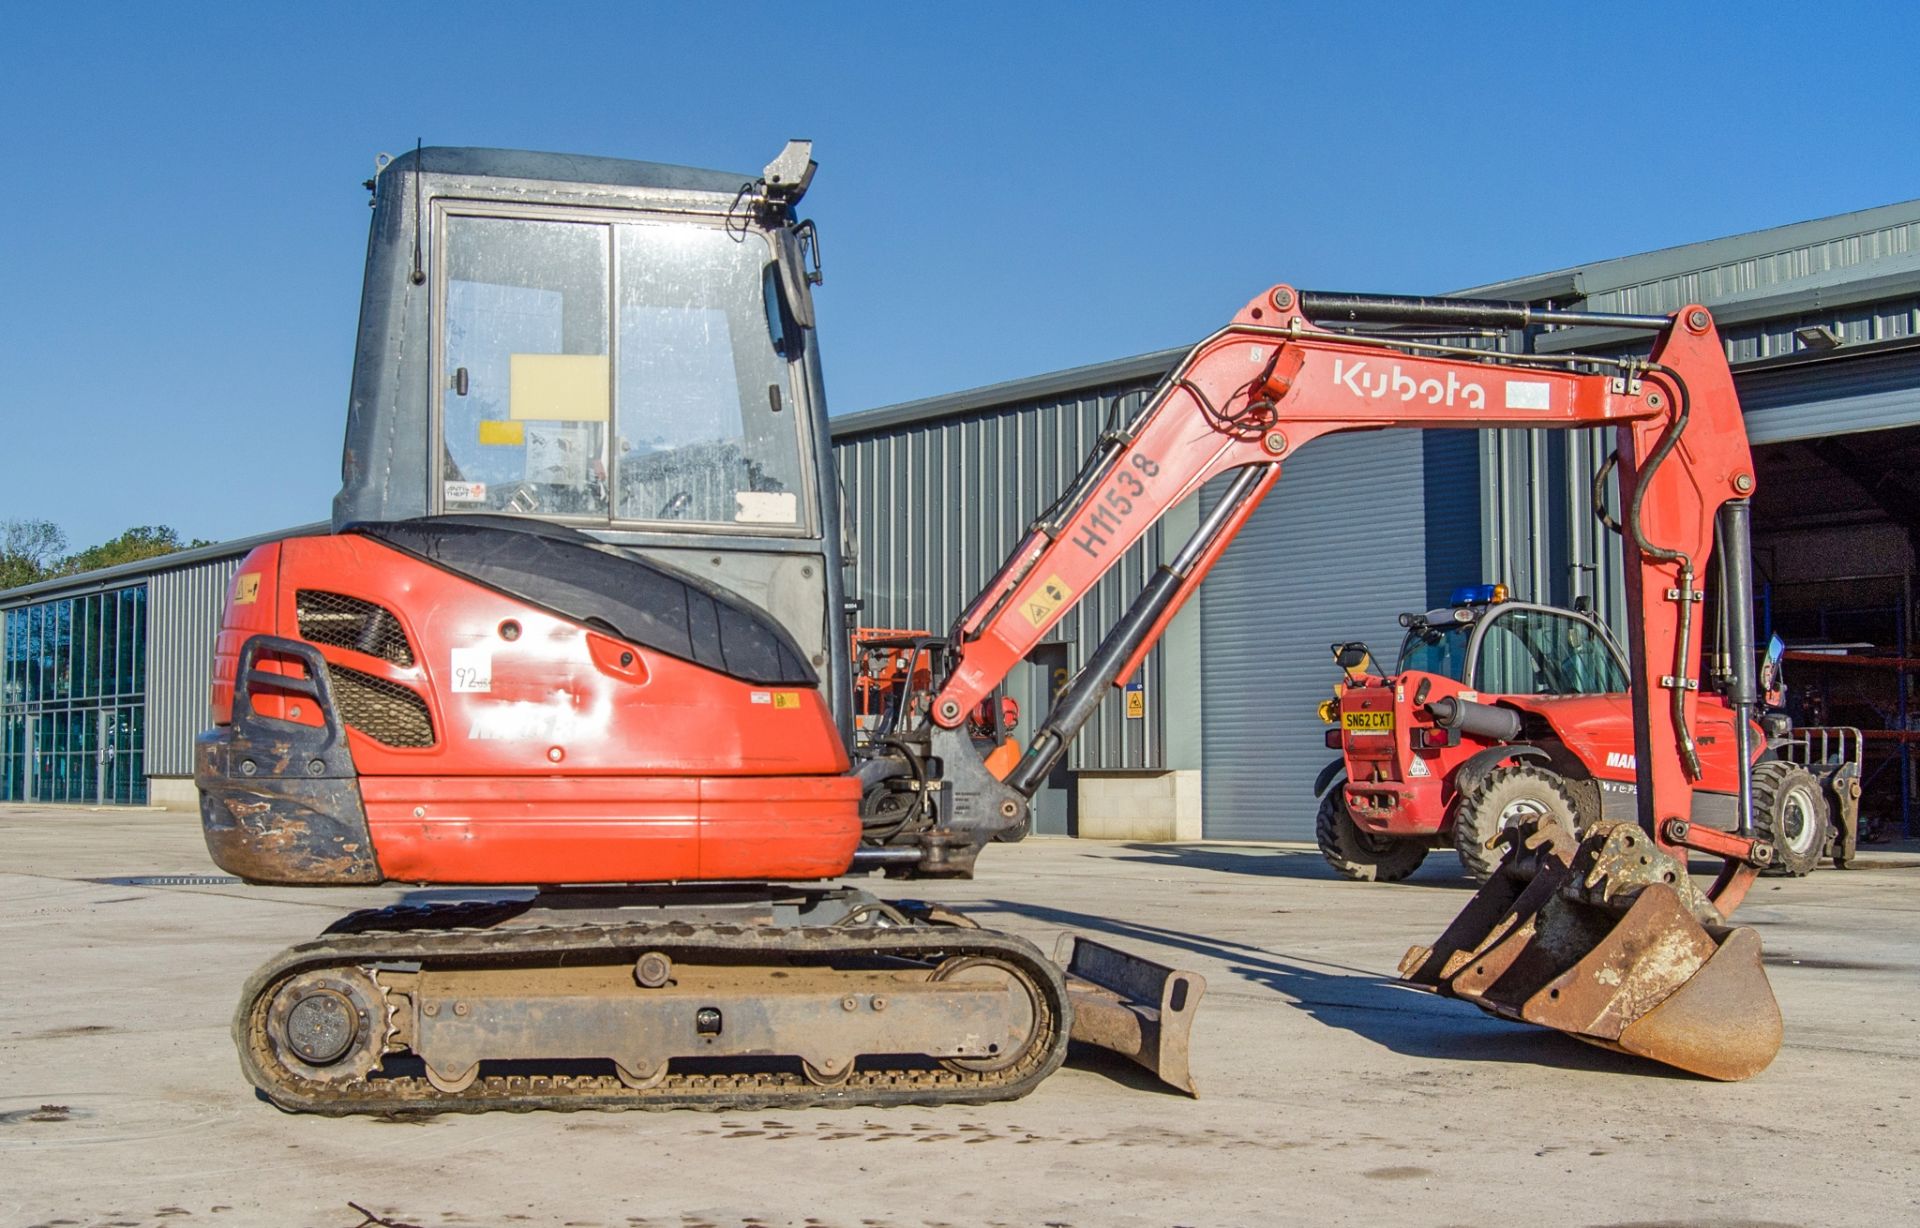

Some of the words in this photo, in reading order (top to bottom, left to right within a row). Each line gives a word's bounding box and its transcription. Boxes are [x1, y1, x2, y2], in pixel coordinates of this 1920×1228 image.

[1334, 359, 1485, 409] Kubota
[1072, 453, 1159, 558] H11538
[456, 667, 477, 688] 92
[1346, 713, 1371, 727] SN62
[1372, 713, 1391, 727] CXT
